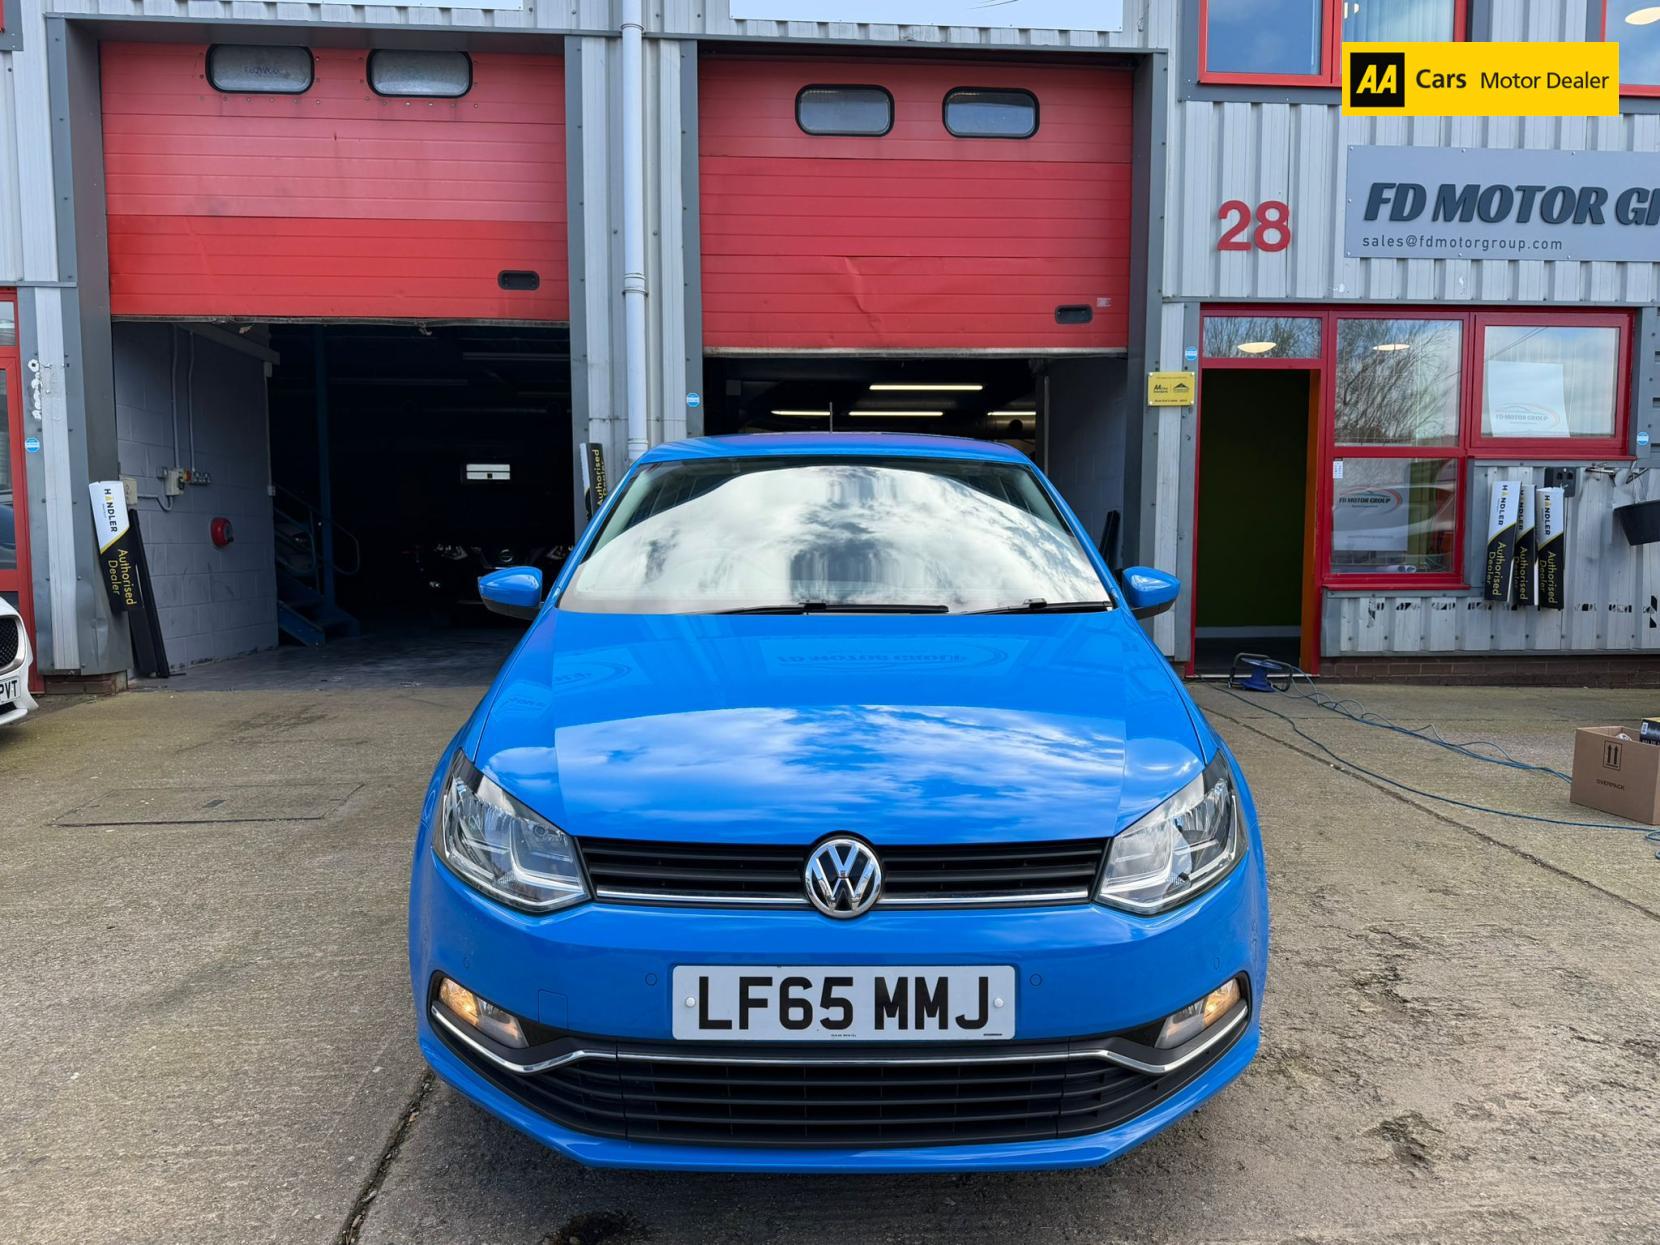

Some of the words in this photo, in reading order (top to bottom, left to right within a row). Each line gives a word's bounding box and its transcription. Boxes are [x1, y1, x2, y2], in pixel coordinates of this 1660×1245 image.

[1216, 200, 1291, 252] 28
[1363, 182, 1427, 222] FD
[1431, 183, 1608, 225] MOTOR
[1362, 234, 1562, 252] sales@fdmotorgroup.com
[104, 488, 118, 532] HANDLER
[1498, 485, 1509, 526] HANDLER
[108, 560, 120, 595] Dealer
[118, 549, 137, 605] Authorised
[1487, 551, 1496, 585] Dealer
[1492, 541, 1507, 596] Authorised
[1520, 546, 1528, 600] Authorised
[1547, 551, 1558, 604] Authorised
[698, 976, 854, 1030] LF65
[874, 976, 989, 1030] MMJ
